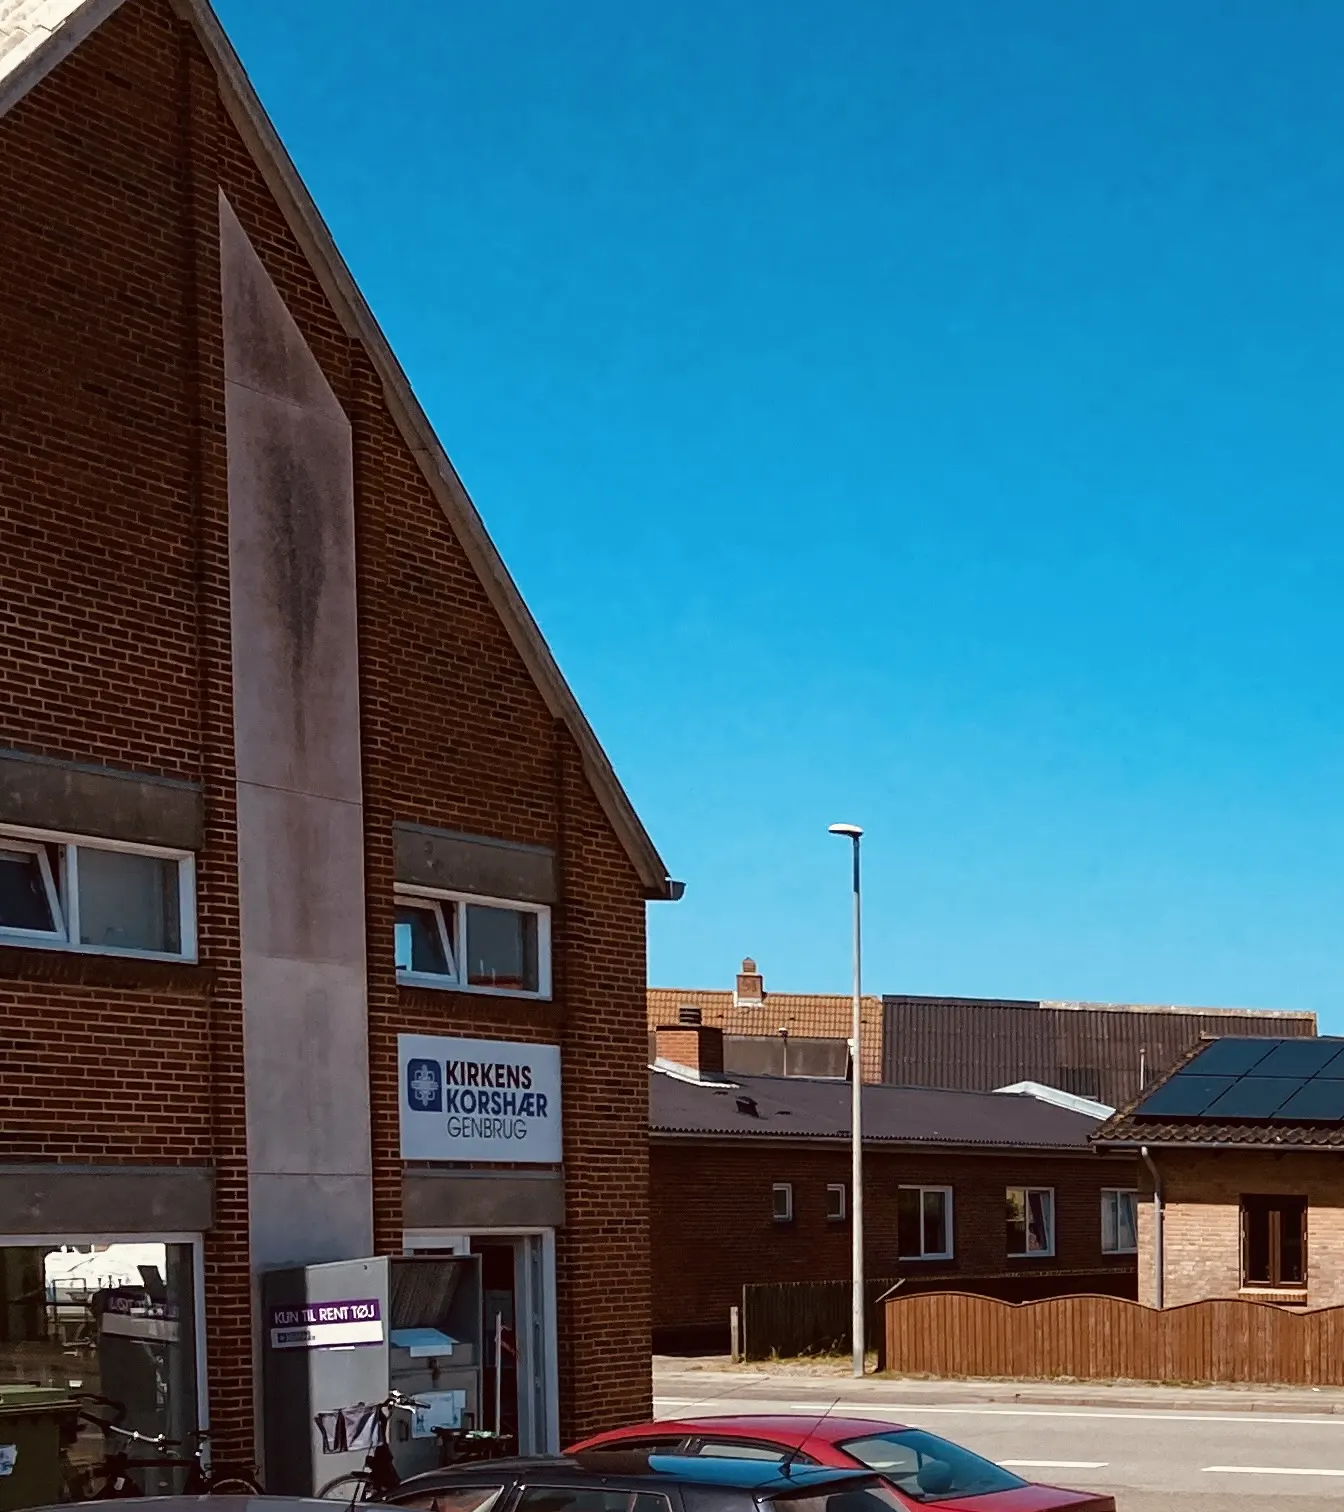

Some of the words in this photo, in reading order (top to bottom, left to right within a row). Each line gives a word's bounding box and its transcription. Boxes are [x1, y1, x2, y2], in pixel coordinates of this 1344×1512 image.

[445, 1060, 532, 1090] KIRKENS
[446, 1088, 548, 1118] KORSHÆR
[447, 1116, 527, 1140] GENBRUG
[274, 1311, 299, 1324] KUN
[301, 1309, 317, 1322] TIL
[318, 1306, 349, 1322] RENT
[350, 1304, 375, 1319] TØJ
